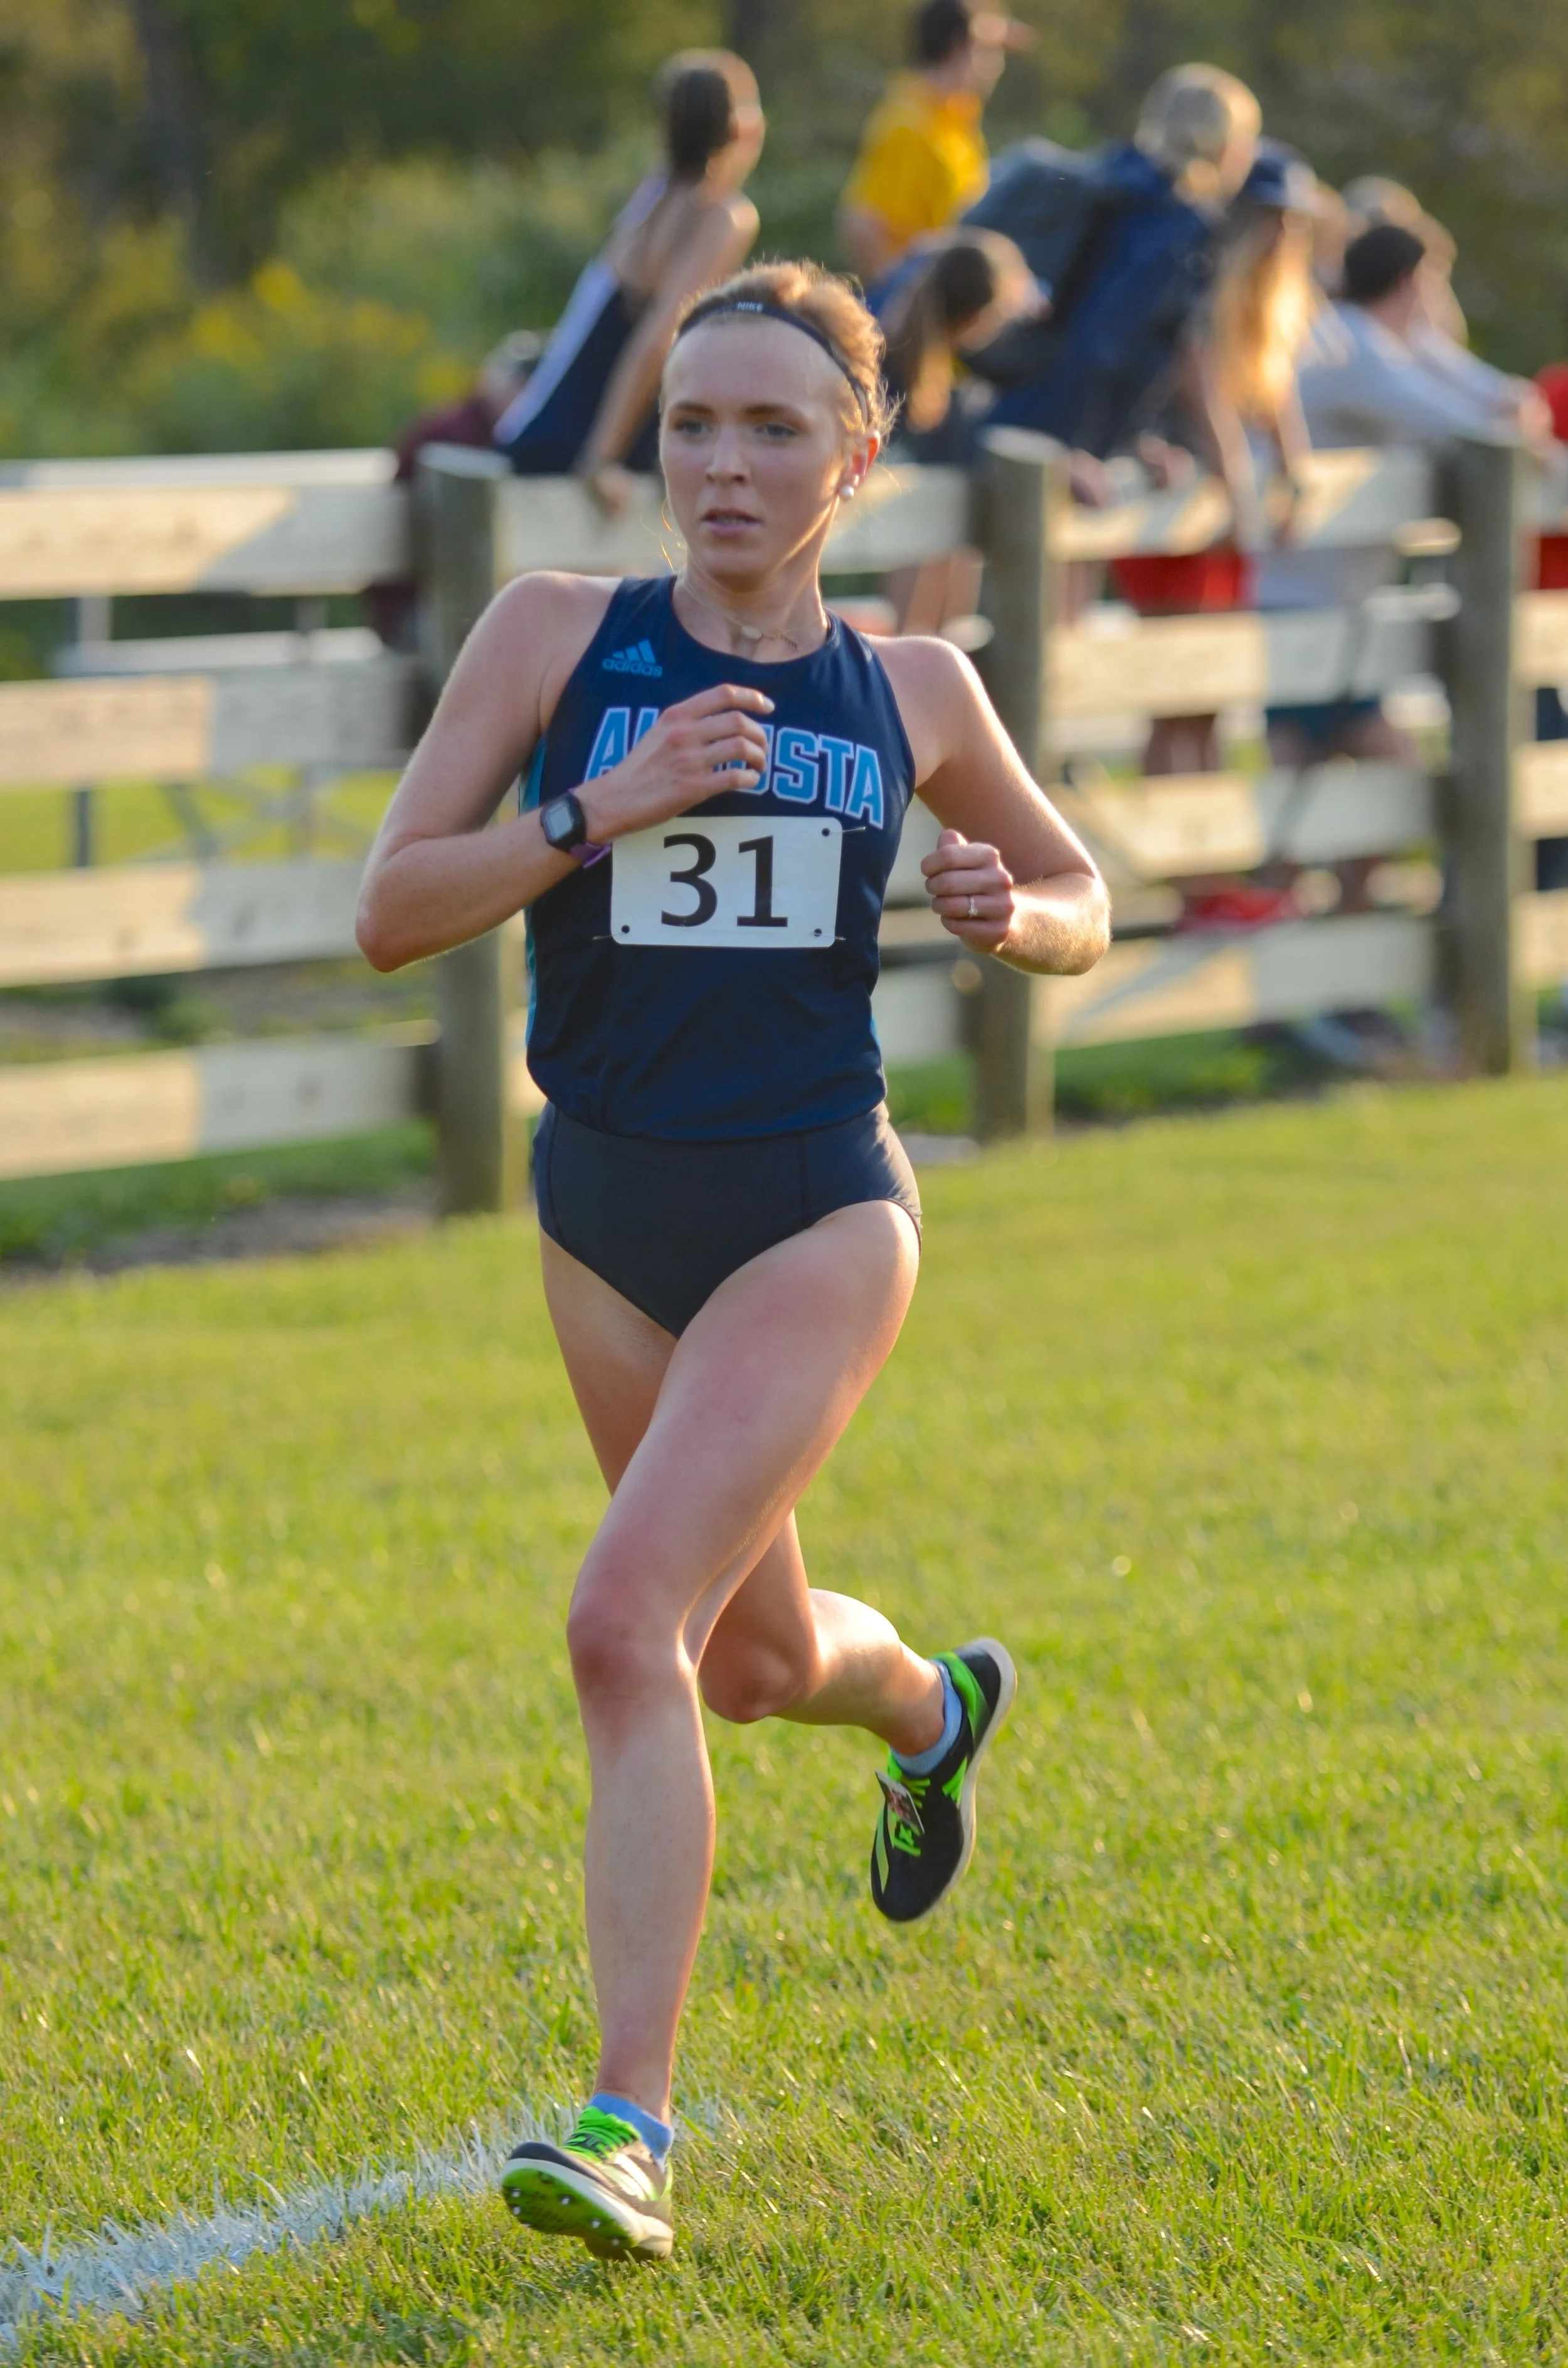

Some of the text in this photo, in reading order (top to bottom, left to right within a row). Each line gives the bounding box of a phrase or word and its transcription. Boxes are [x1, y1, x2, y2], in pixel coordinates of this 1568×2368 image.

[737, 302, 763, 313] NIKE
[602, 659, 663, 677] adidas
[583, 707, 884, 829] ASTA
[661, 833, 788, 928] 31
